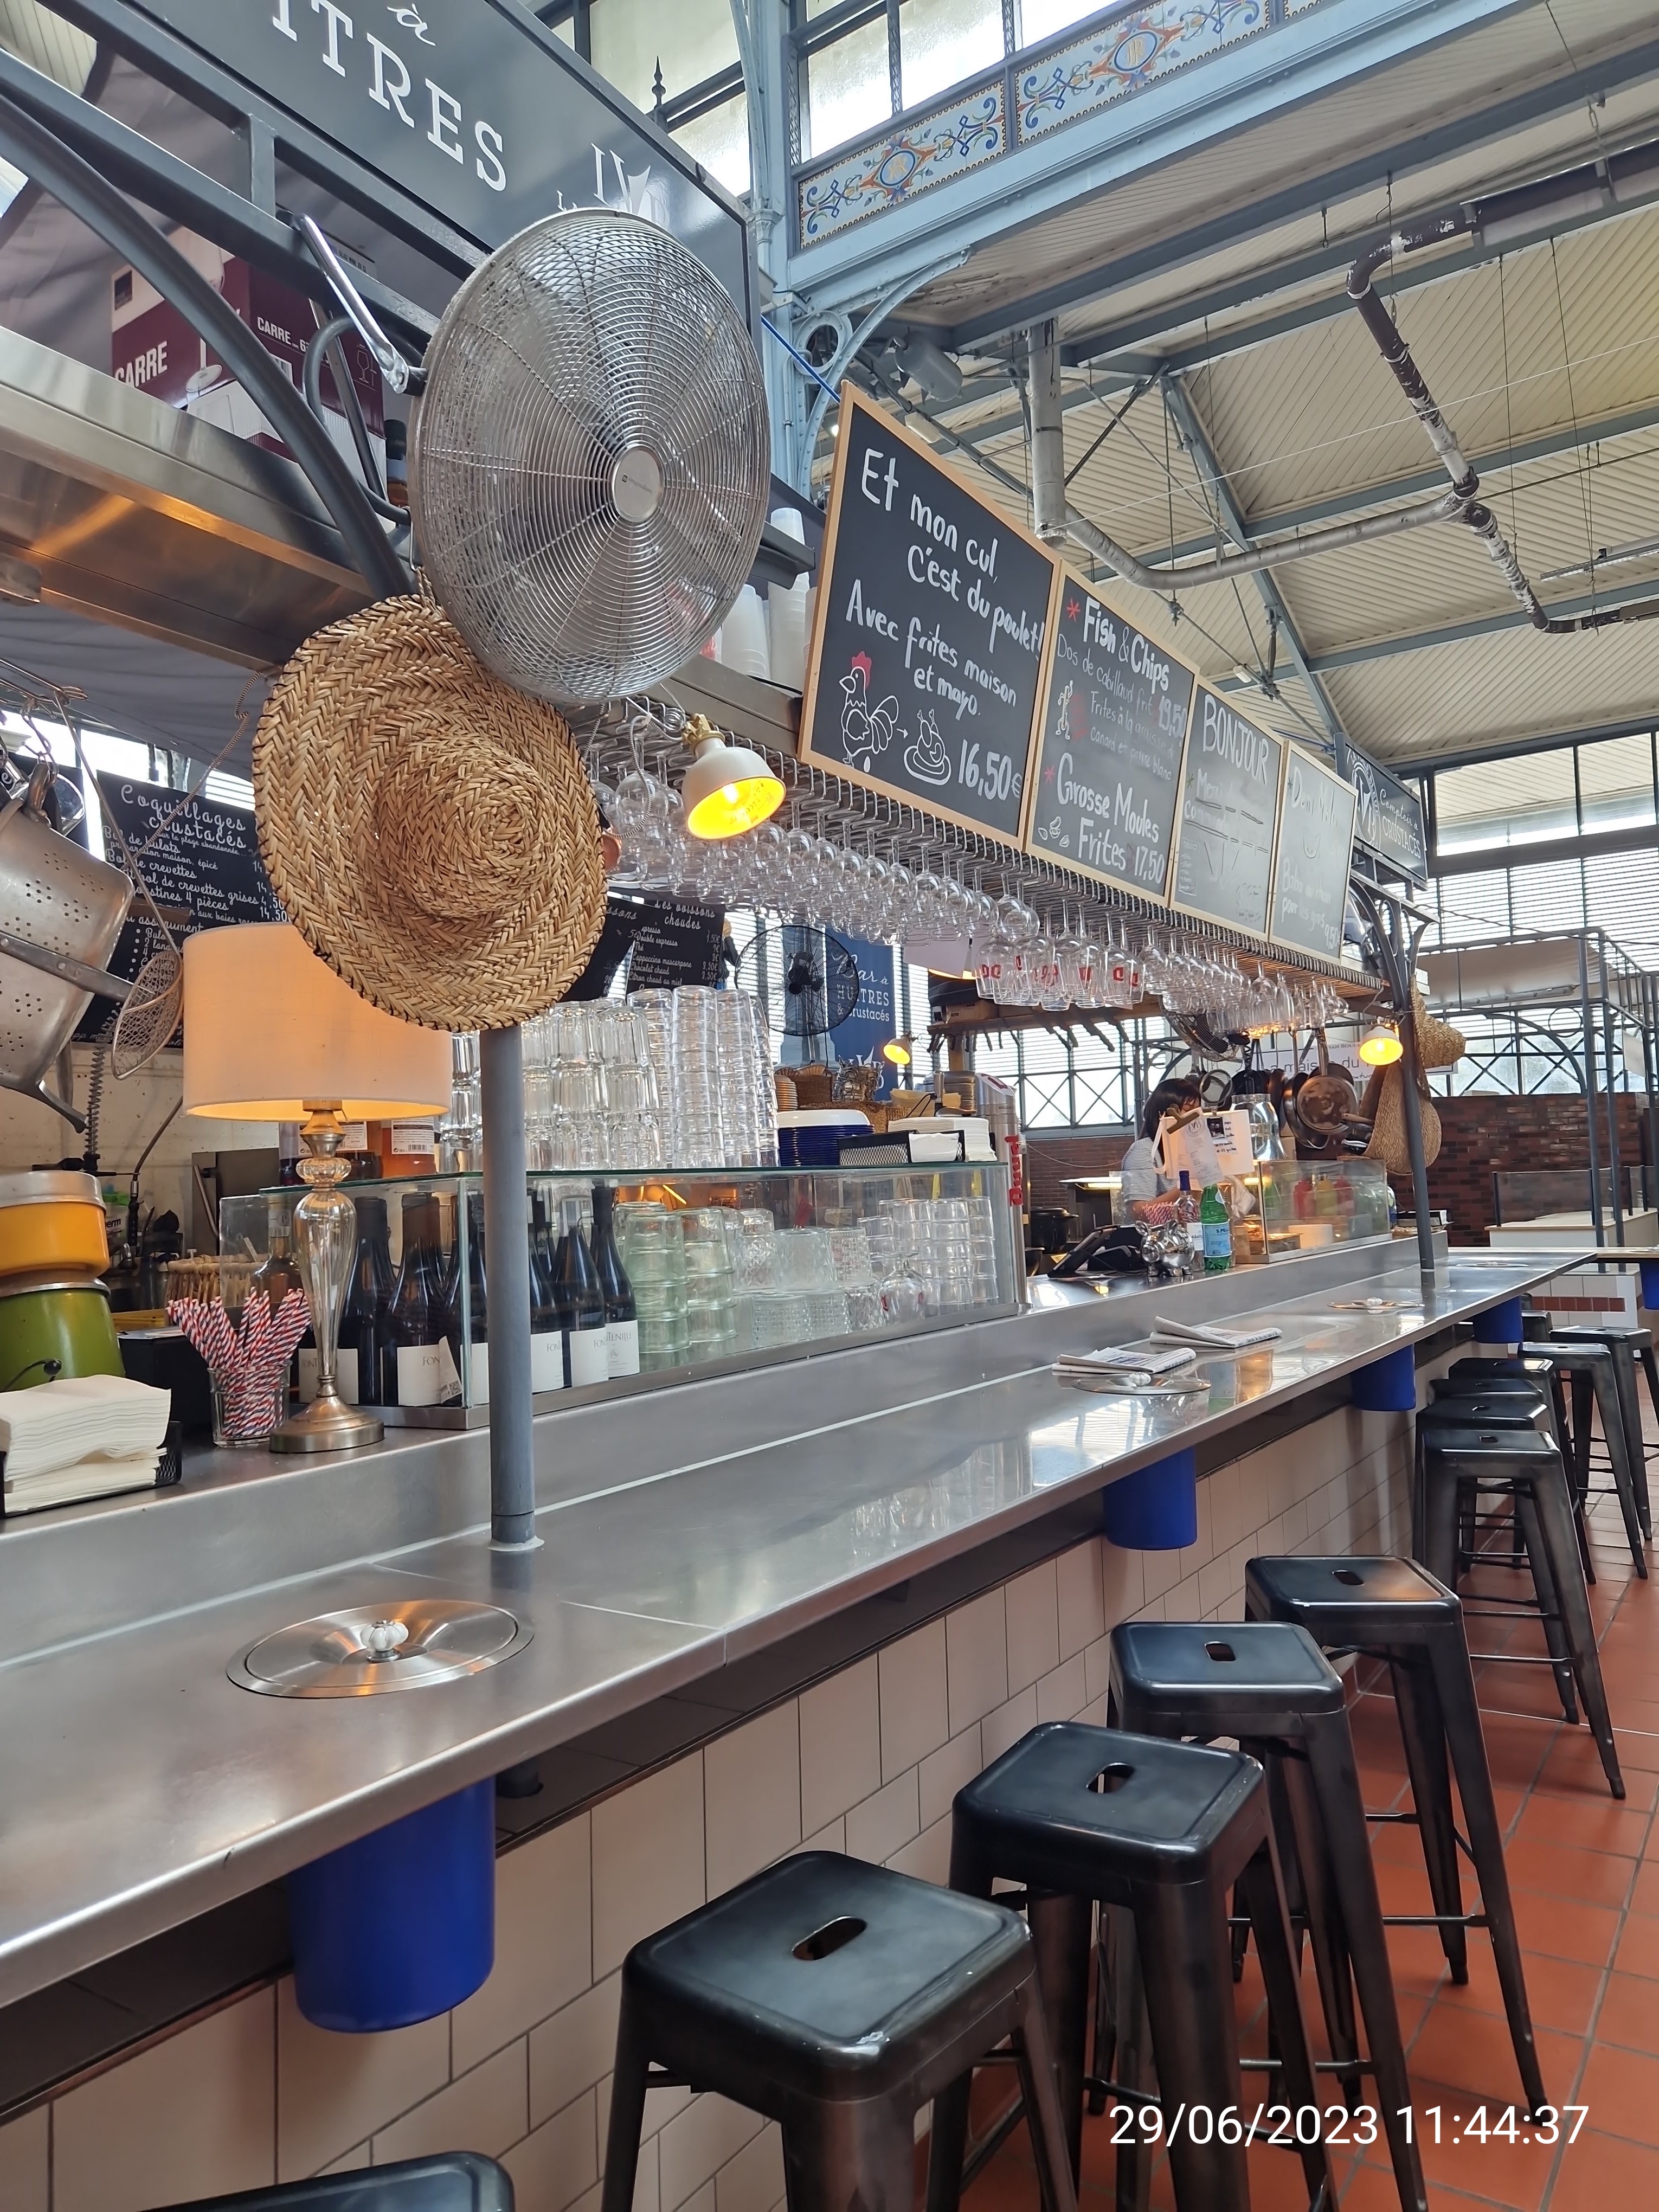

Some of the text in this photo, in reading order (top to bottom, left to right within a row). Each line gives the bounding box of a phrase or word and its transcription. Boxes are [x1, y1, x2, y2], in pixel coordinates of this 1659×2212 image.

[387, 3, 436, 46] à
[861, 448, 899, 512] Et
[910, 494, 957, 552] mon
[908, 544, 1045, 660] C'est du poulet!
[846, 578, 1017, 707] Avec frites maison
[1083, 596, 1169, 695] Fish & Chips
[914, 666, 934, 692] et
[1057, 634, 1078, 666] Dos
[1083, 648, 1094, 676] de
[1097, 667, 1134, 703] cabillaud
[1091, 691, 1116, 722] Frites
[1126, 710, 1133, 734] la
[1203, 693, 1269, 785] BONJOUR
[121, 785, 246, 832] Coquillages
[1057, 753, 1110, 819] Grosse
[1114, 783, 1159, 843] Moules
[1380, 788, 1419, 831] Comptoir à
[128, 832, 143, 845] de
[181, 835, 200, 848] plage
[1078, 817, 1127, 872] Frites
[1382, 815, 1422, 859] CRUSTACÉS
[149, 862, 197, 879] crevettes
[198, 859, 218, 871] épicé
[1283, 857, 1303, 893] Baba
[162, 875, 175, 888] de
[178, 882, 225, 897] crevettes
[228, 891, 259, 905] grises
[186, 892, 192, 904] 4
[197, 896, 229, 911] pièces
[215, 911, 236, 923] baies
[664, 912, 702, 930] chaudes
[634, 941, 644, 951] Thé
[635, 931, 655, 943] Double
[655, 938, 678, 948] expresso
[630, 962, 654, 973] Chocolat
[632, 951, 661, 965] Cappuccino
[662, 958, 692, 971] mascarpone
[837, 984, 890, 1007] HUTRES
[880, 976, 889, 985] à
[1342, 1056, 1360, 1069] du
